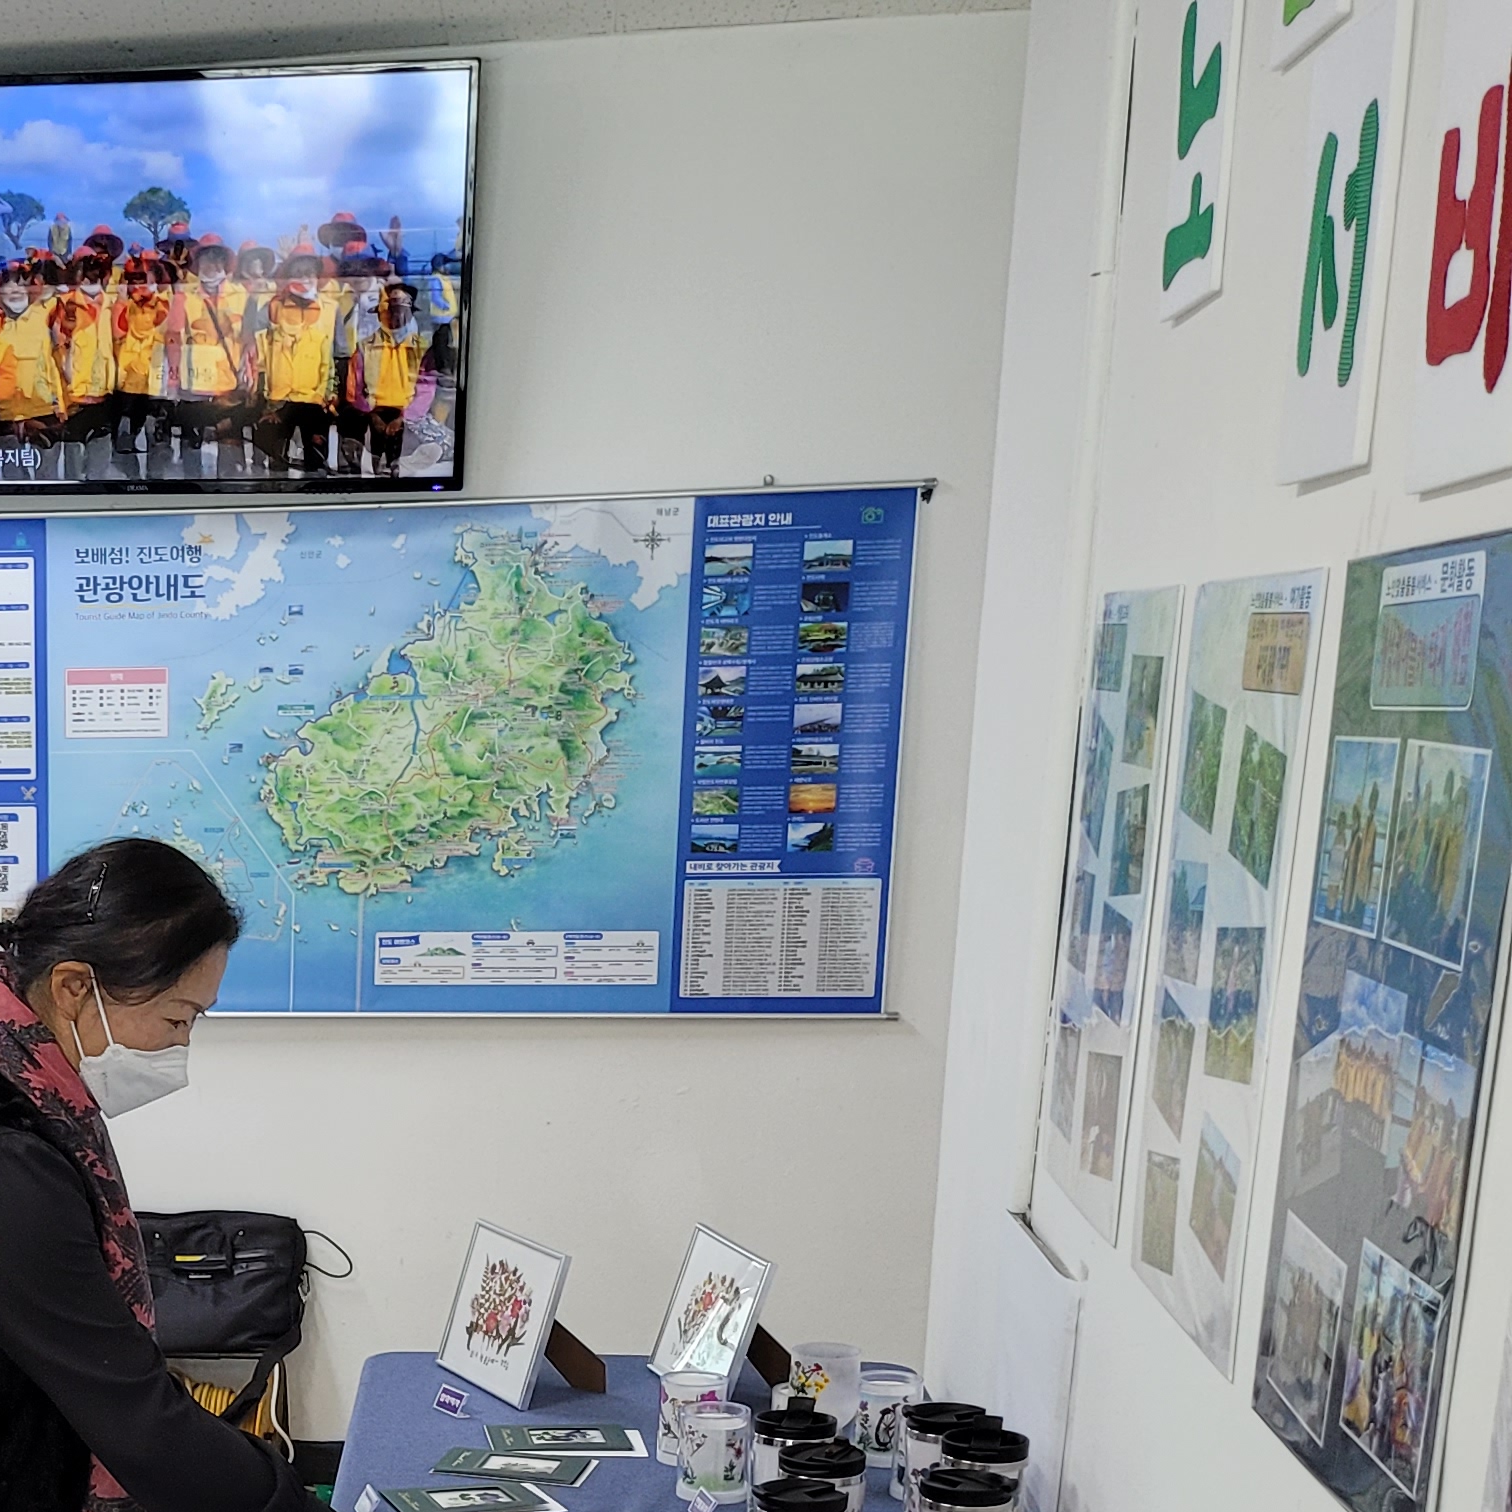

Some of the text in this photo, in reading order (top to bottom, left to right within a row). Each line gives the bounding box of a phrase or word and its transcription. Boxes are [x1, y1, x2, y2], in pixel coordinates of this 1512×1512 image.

[706, 512, 793, 528] 대표관광지 안내
[74, 543, 203, 566] 보배섬! 진도여행
[73, 572, 207, 604] 관광안내도
[103, 611, 127, 621] Guide
[127, 611, 146, 622] Map
[146, 610, 156, 620] of
[179, 610, 209, 622] County
[689, 860, 775, 872] 내비로 찾아가는 관광지
